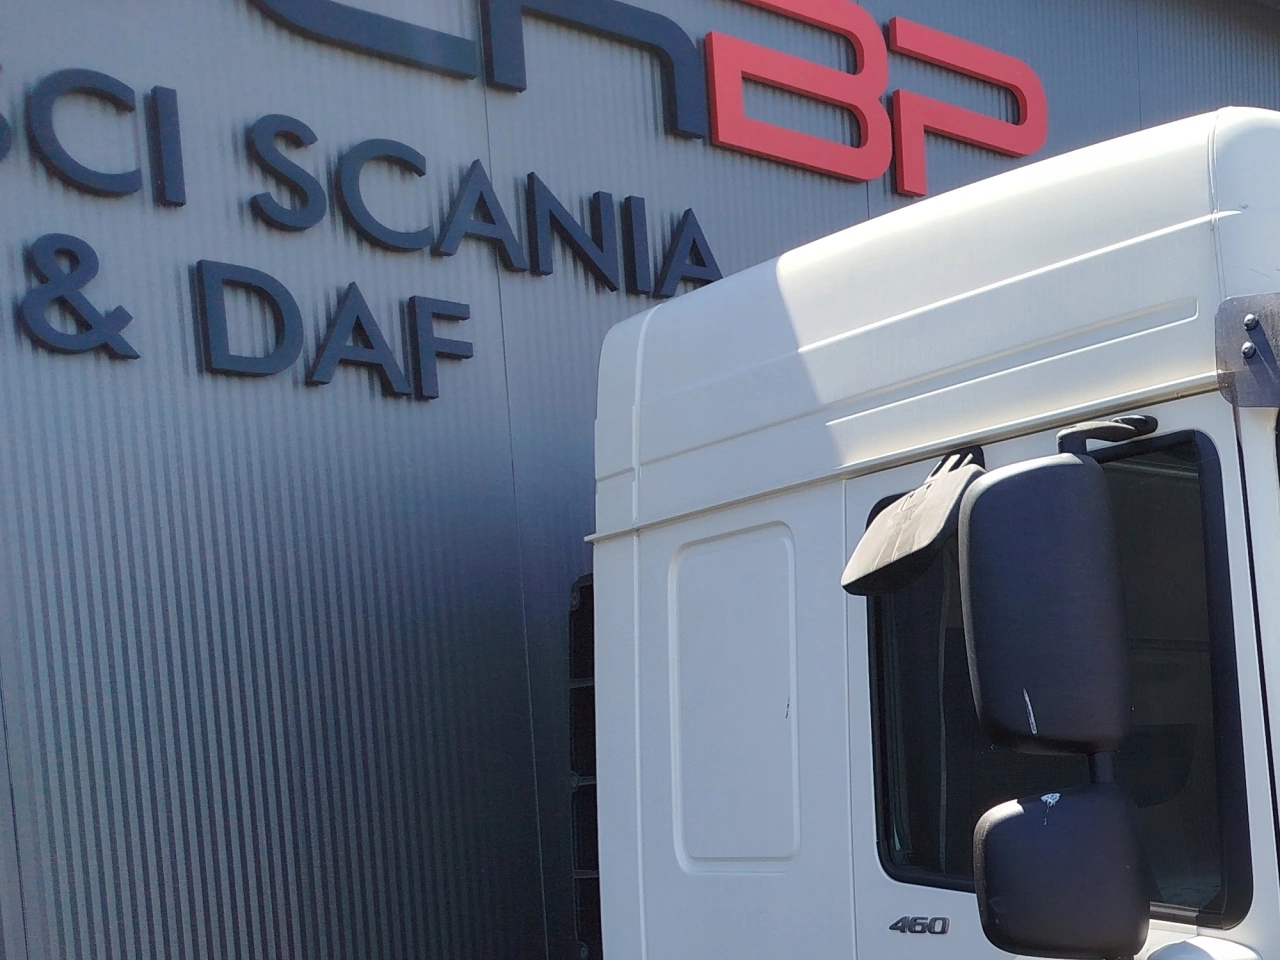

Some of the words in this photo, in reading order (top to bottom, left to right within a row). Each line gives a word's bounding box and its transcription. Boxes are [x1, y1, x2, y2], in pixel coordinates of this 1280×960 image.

[0, 66, 187, 208] CI
[247, 113, 722, 299] SCANIA
[20, 233, 140, 360] &
[198, 259, 474, 400] DAF
[888, 915, 951, 935] 460
